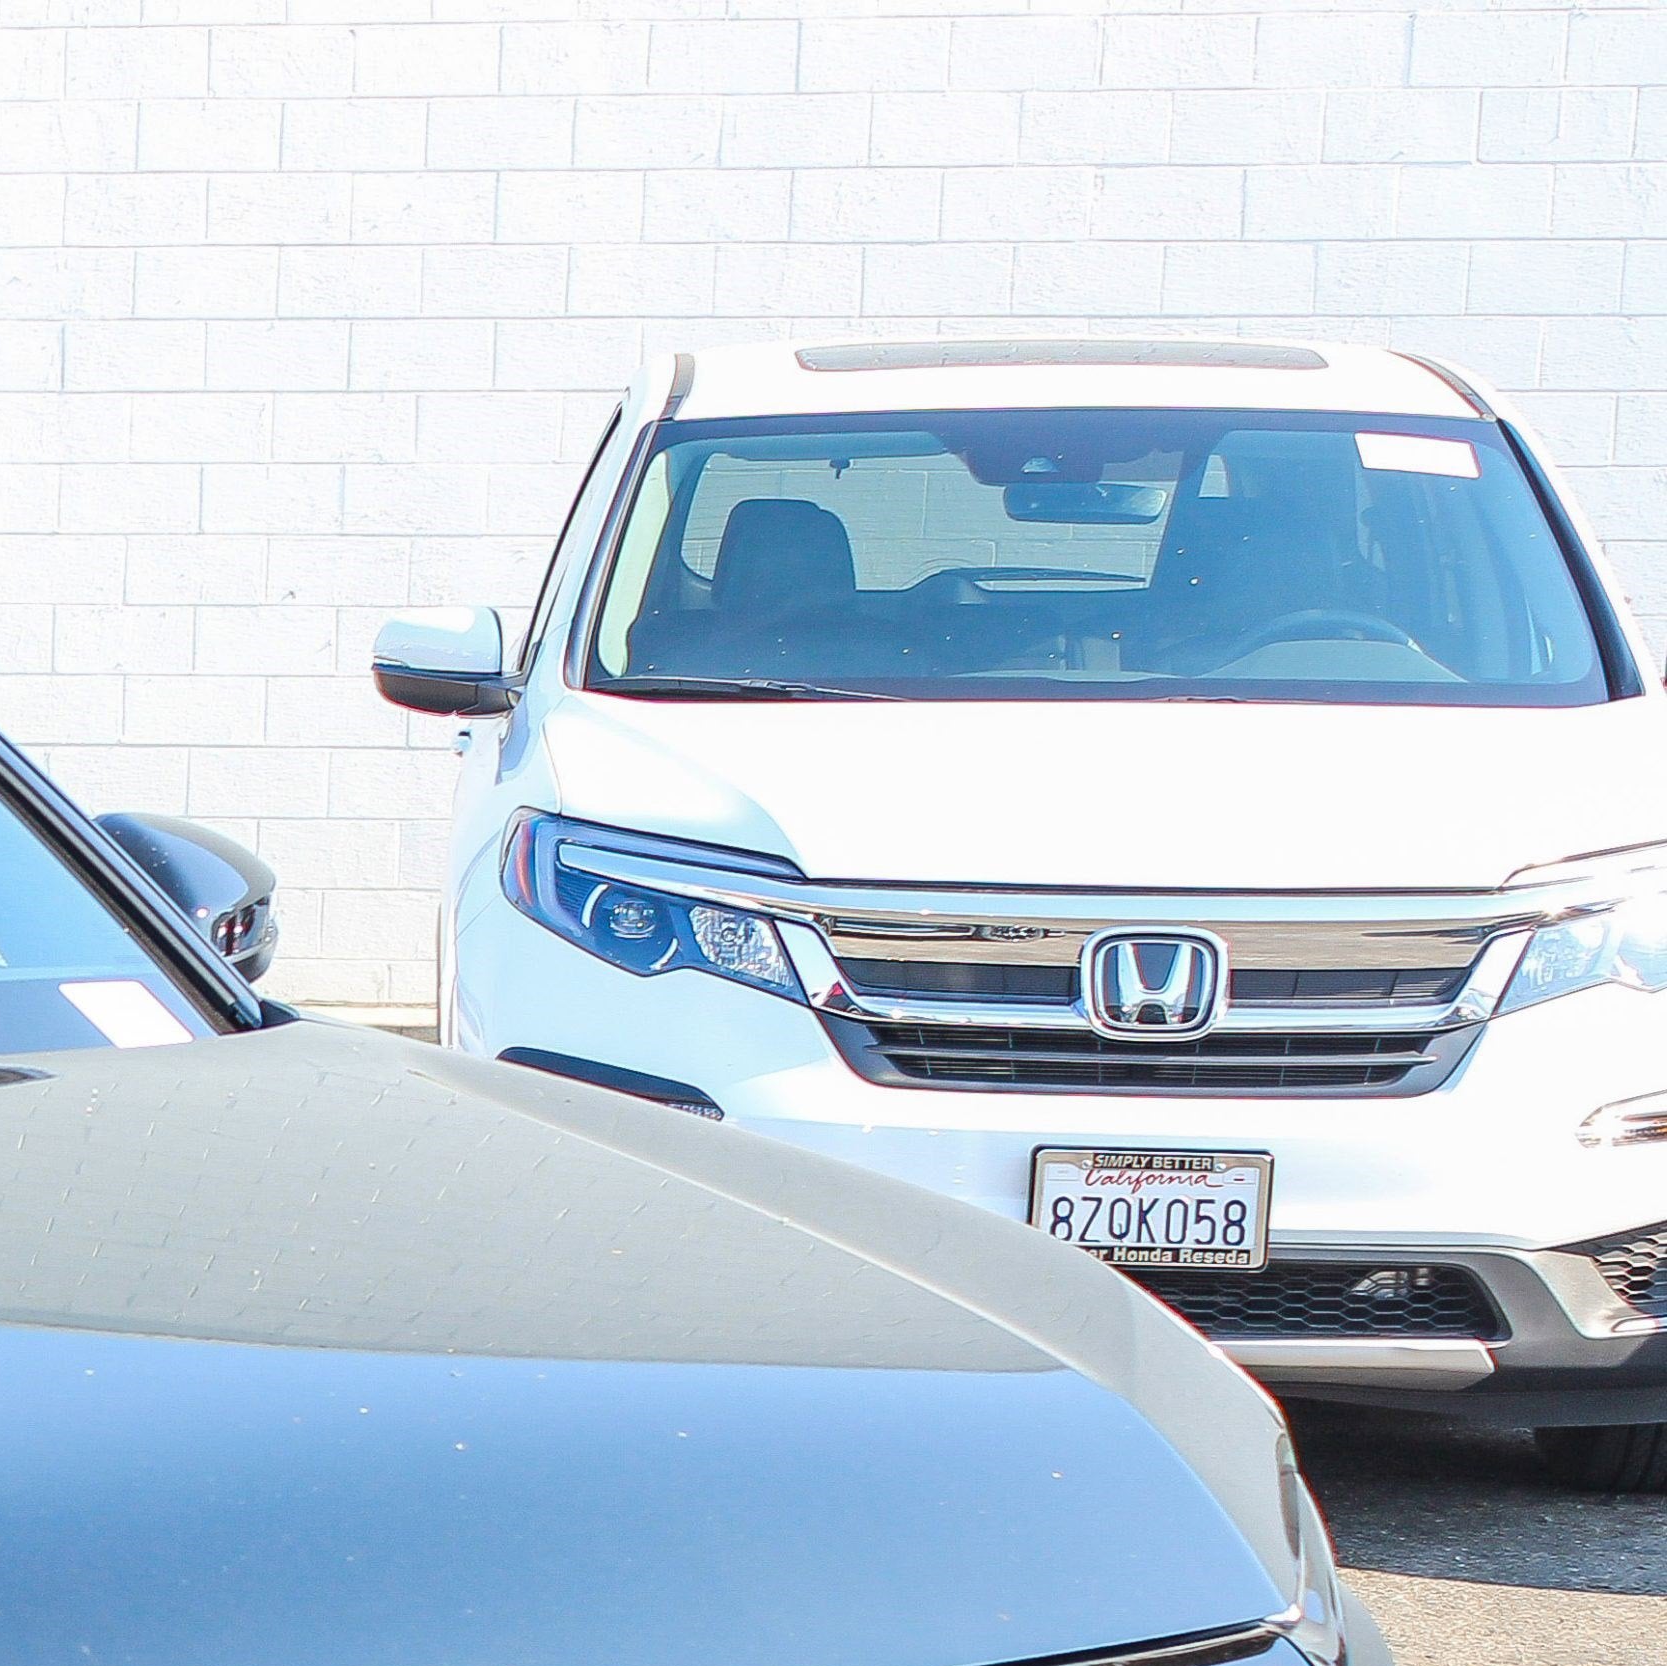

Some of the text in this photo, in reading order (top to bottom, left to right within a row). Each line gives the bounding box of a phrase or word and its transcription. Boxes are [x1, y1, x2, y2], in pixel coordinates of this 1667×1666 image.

[1094, 1154, 1212, 1171] SIMPLY BETTER
[1084, 1168, 1223, 1194] California
[1050, 1195, 1247, 1246] 8ZQK058
[1113, 1247, 1173, 1262] Honda
[1179, 1249, 1250, 1264] Reseda
